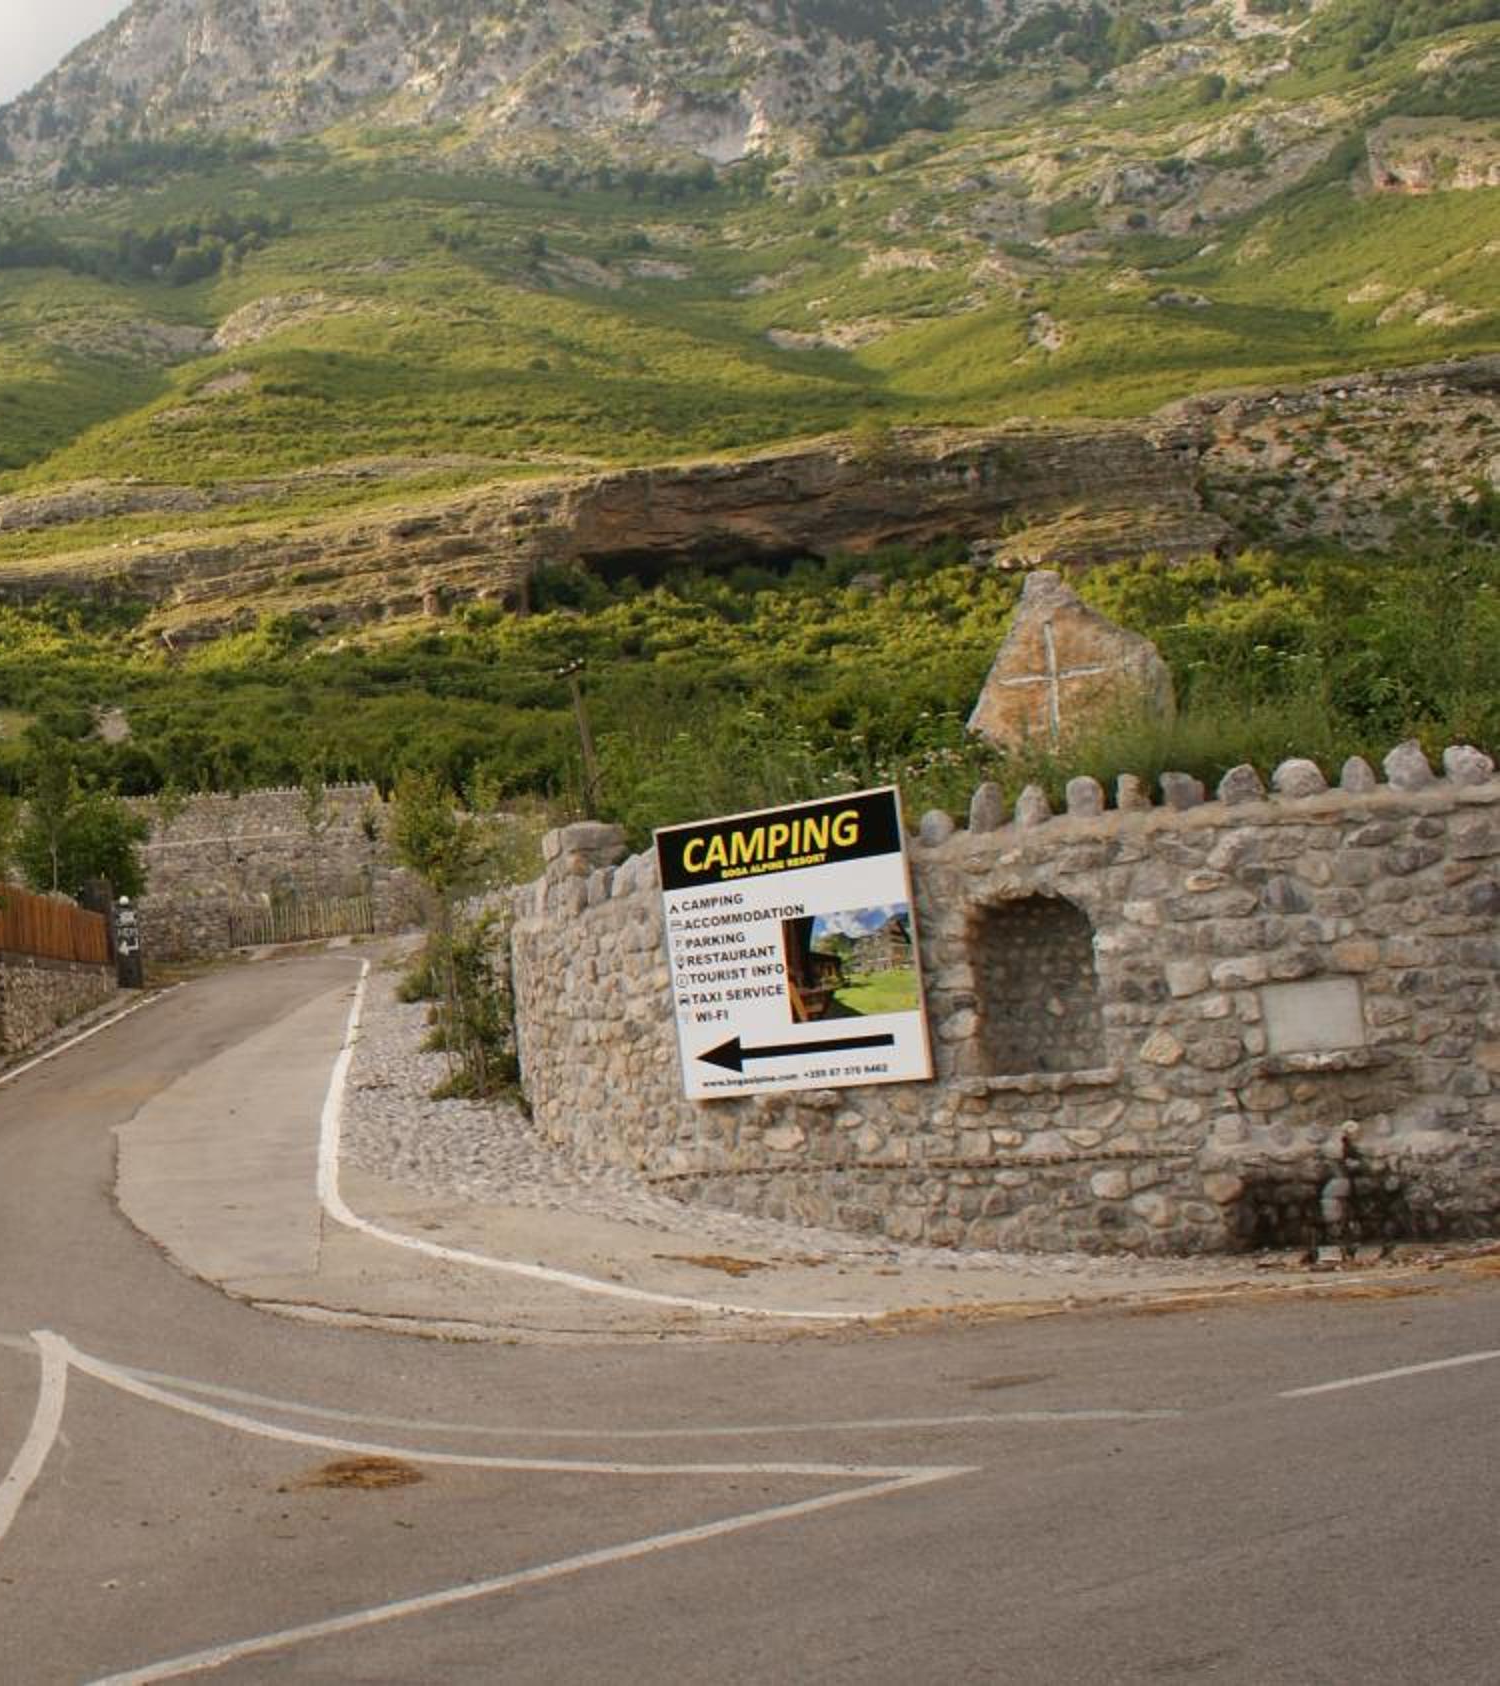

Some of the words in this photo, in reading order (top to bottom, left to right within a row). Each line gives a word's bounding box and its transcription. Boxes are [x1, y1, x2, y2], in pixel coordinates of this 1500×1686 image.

[683, 810, 860, 873] CAMPING
[750, 860, 785, 874] ALPINE
[787, 853, 827, 867] RESORT
[682, 893, 744, 912] CAMPING
[684, 903, 806, 931] ACCOMMODATION
[686, 932, 746, 949] PARKING
[687, 945, 776, 967] RESTAURANT
[690, 967, 748, 984] TOURIST
[752, 963, 785, 977] INFO
[692, 992, 724, 1004] TAXI
[725, 984, 785, 1001] SERVICE
[696, 1009, 729, 1022] WI-FI
